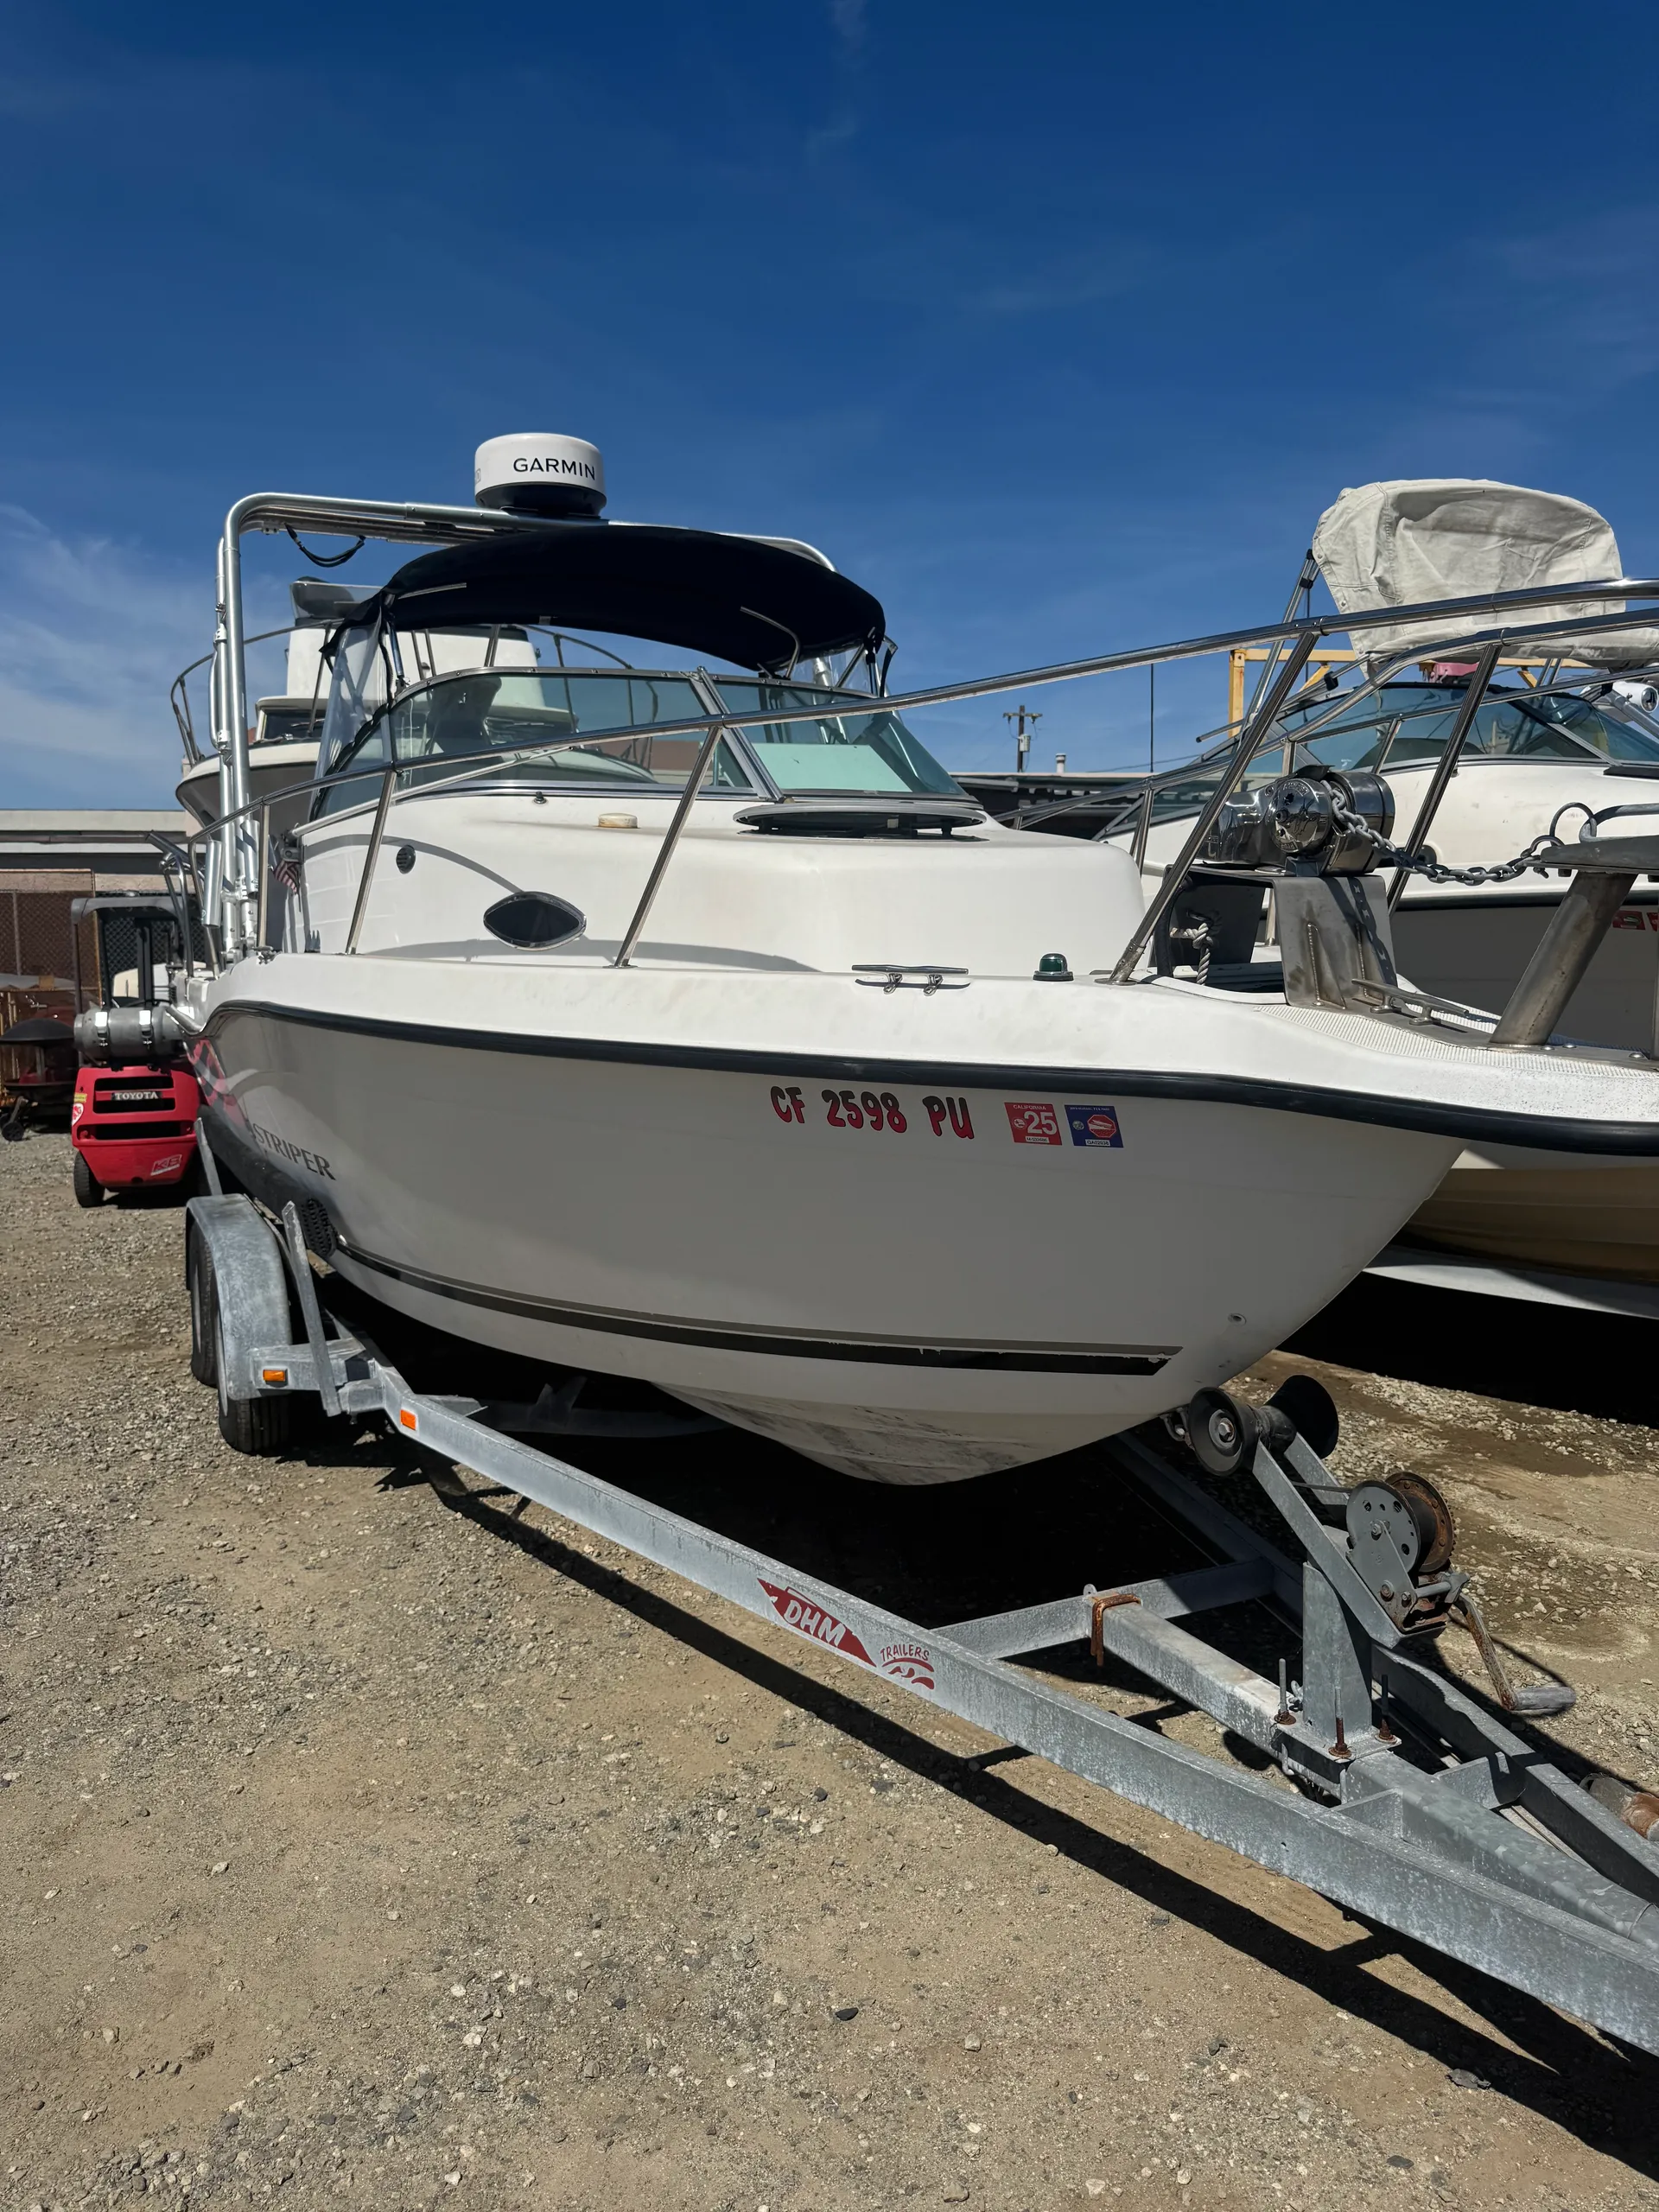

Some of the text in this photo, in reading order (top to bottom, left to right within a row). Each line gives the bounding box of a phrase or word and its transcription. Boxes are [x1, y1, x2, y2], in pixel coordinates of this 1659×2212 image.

[512, 457, 596, 481] GARMIN
[113, 1091, 159, 1101] TOYOTA
[770, 1085, 975, 1140] CF 2598 PU
[1023, 1110, 1058, 1135] 25
[252, 1122, 337, 1181] STRIPER
[784, 1599, 848, 1648] DHM
[880, 1643, 930, 1662] TRAILERS
